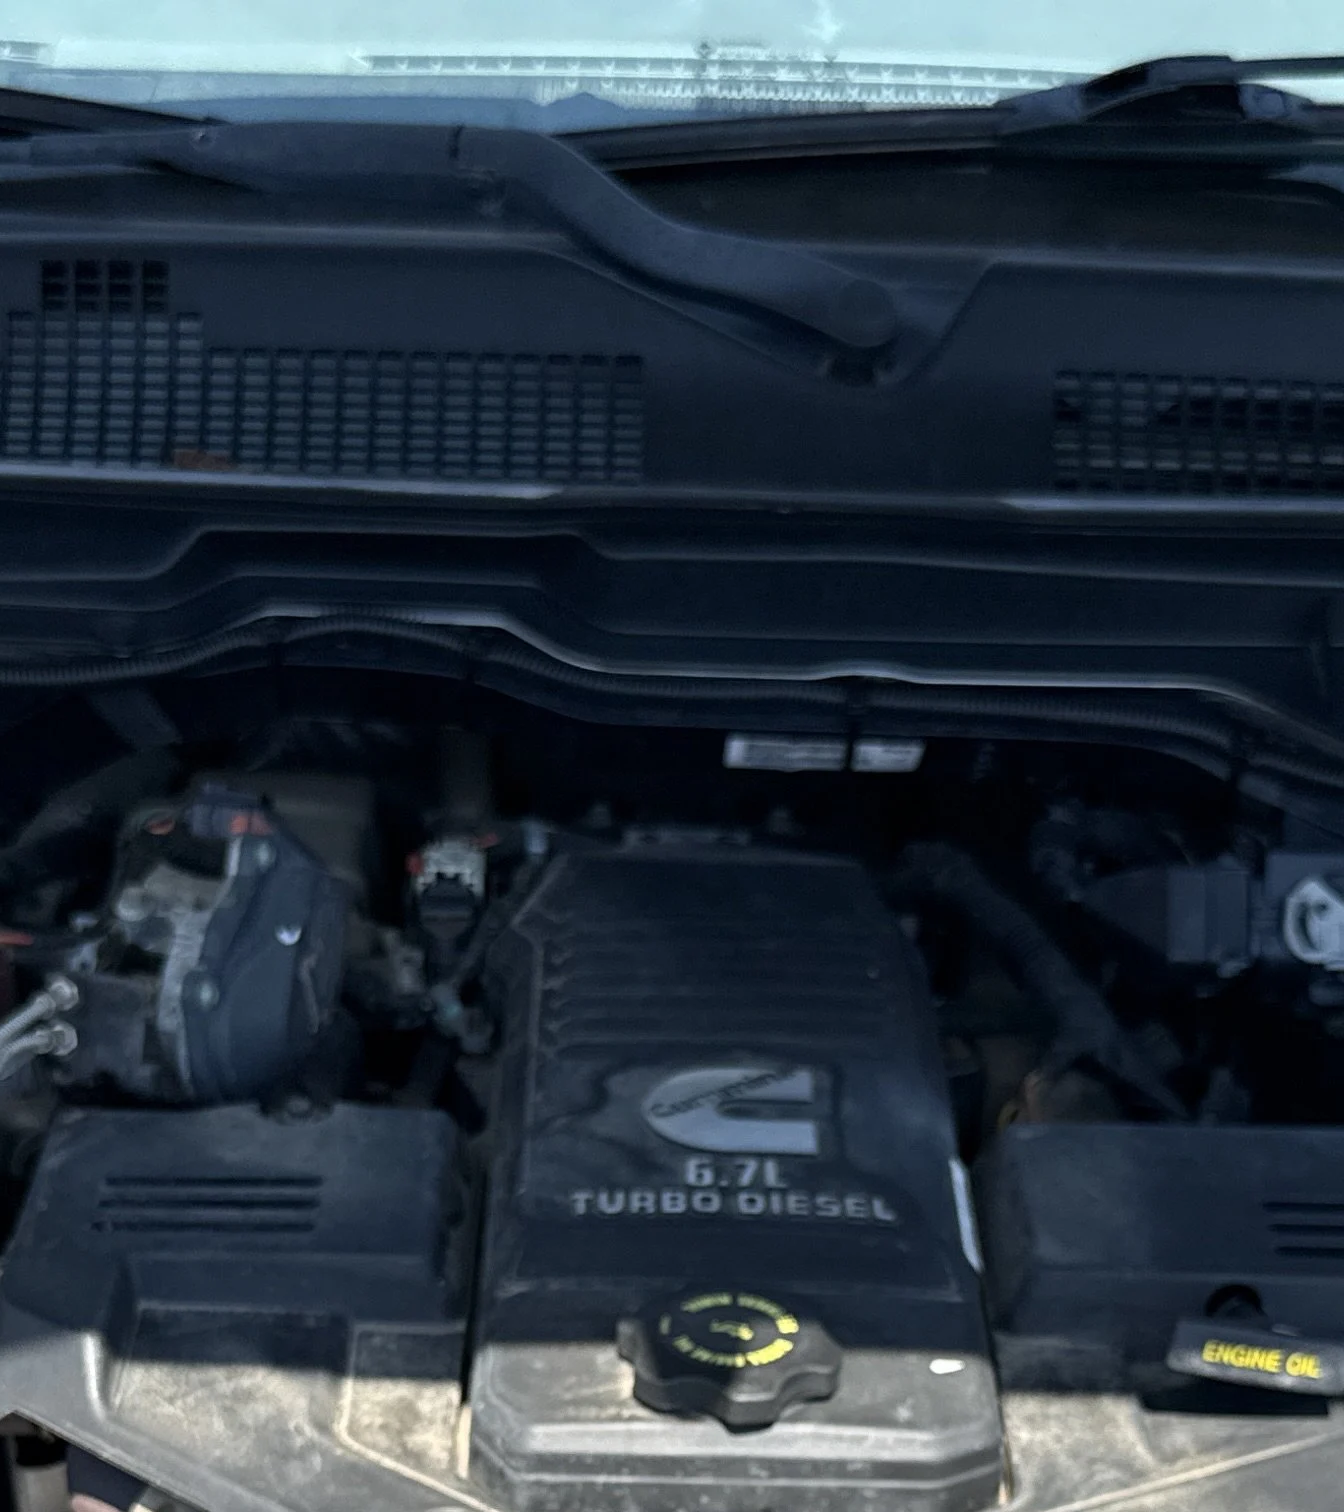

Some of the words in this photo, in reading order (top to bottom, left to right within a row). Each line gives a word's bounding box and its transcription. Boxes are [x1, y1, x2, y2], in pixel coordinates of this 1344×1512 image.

[685, 1156, 788, 1188] 6.7L
[570, 1190, 722, 1216] TURBO
[736, 1191, 899, 1222] DIESEL
[1201, 1339, 1281, 1374] ENGINE
[1285, 1351, 1324, 1380] OIL
